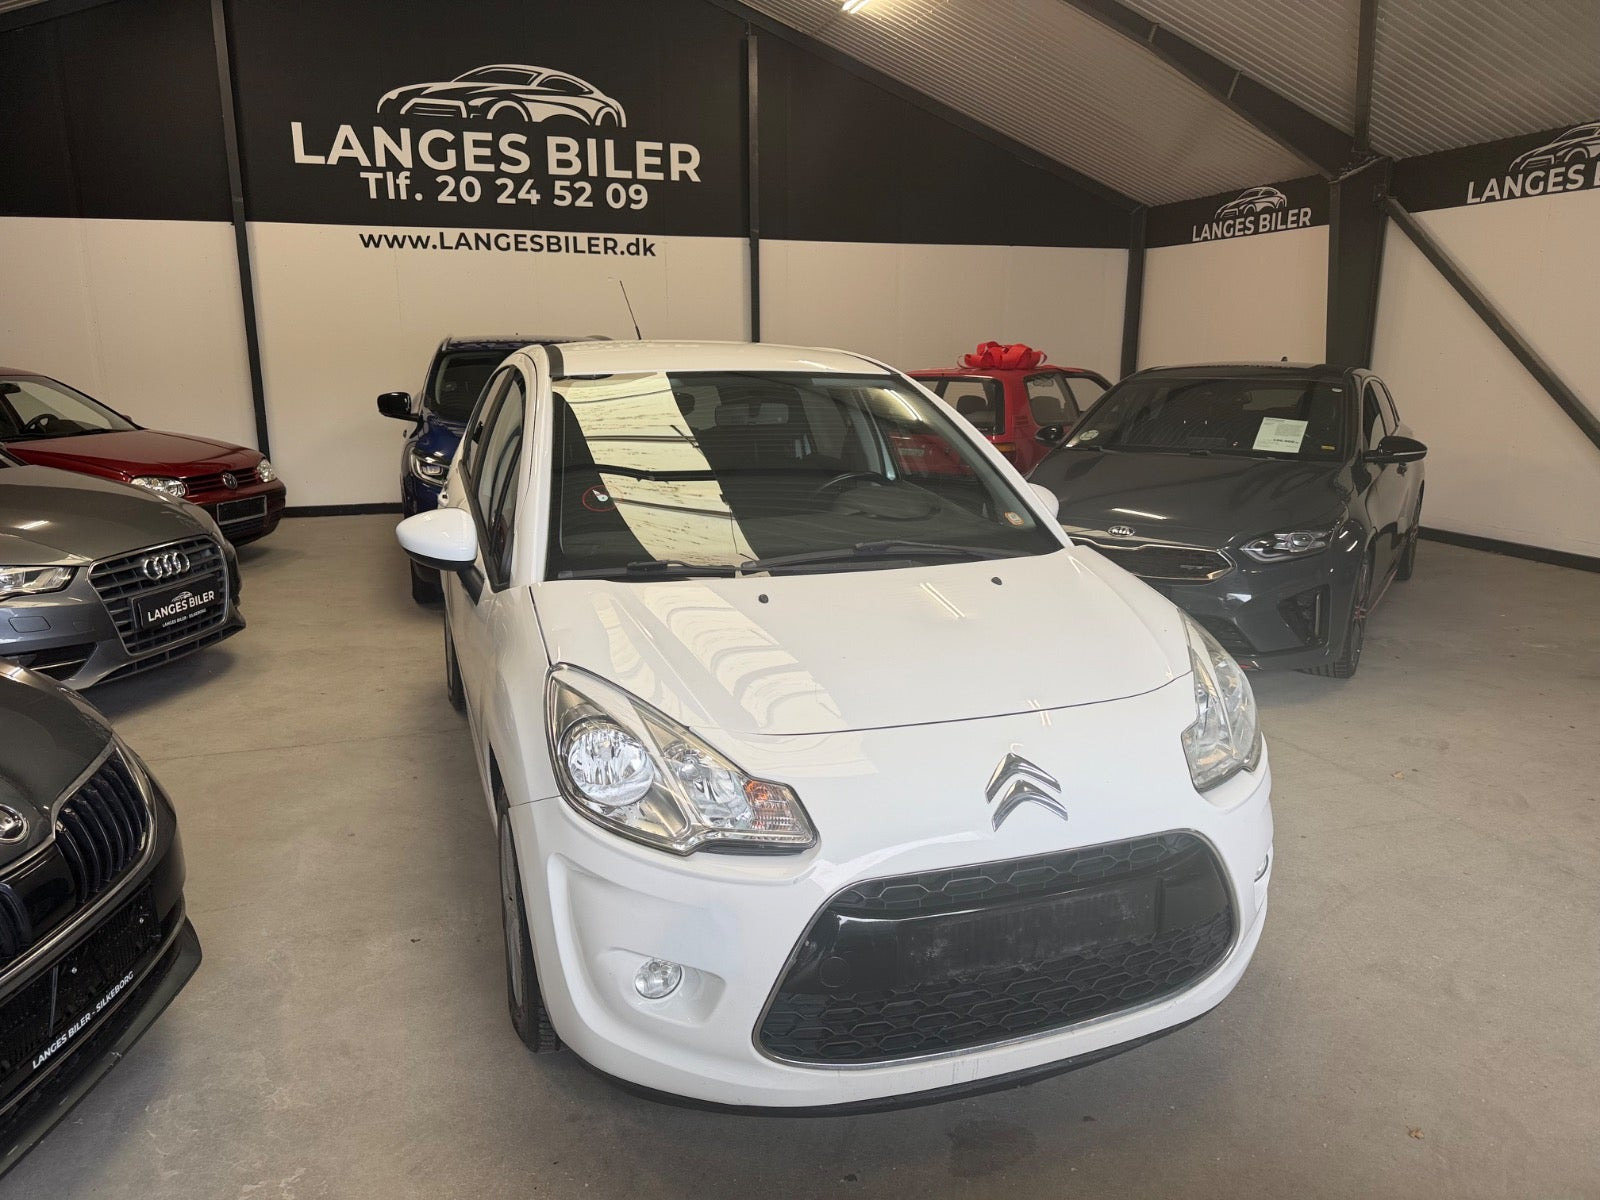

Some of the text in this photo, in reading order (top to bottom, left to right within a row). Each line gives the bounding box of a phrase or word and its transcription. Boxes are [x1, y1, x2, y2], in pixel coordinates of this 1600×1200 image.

[291, 121, 701, 183] LANGES BILER
[360, 171, 649, 210] Tlf. 20 24 52 09
[1466, 164, 1585, 205] LANGES
[359, 231, 657, 257] www.LANGESBILER.dk
[1192, 207, 1312, 242] LANGES BILER
[147, 600, 188, 622] LANGES
[189, 590, 215, 608] BILER
[32, 1033, 67, 1070] LANGES
[68, 1012, 91, 1039] BILER
[95, 970, 134, 1013] SILKEBORG
